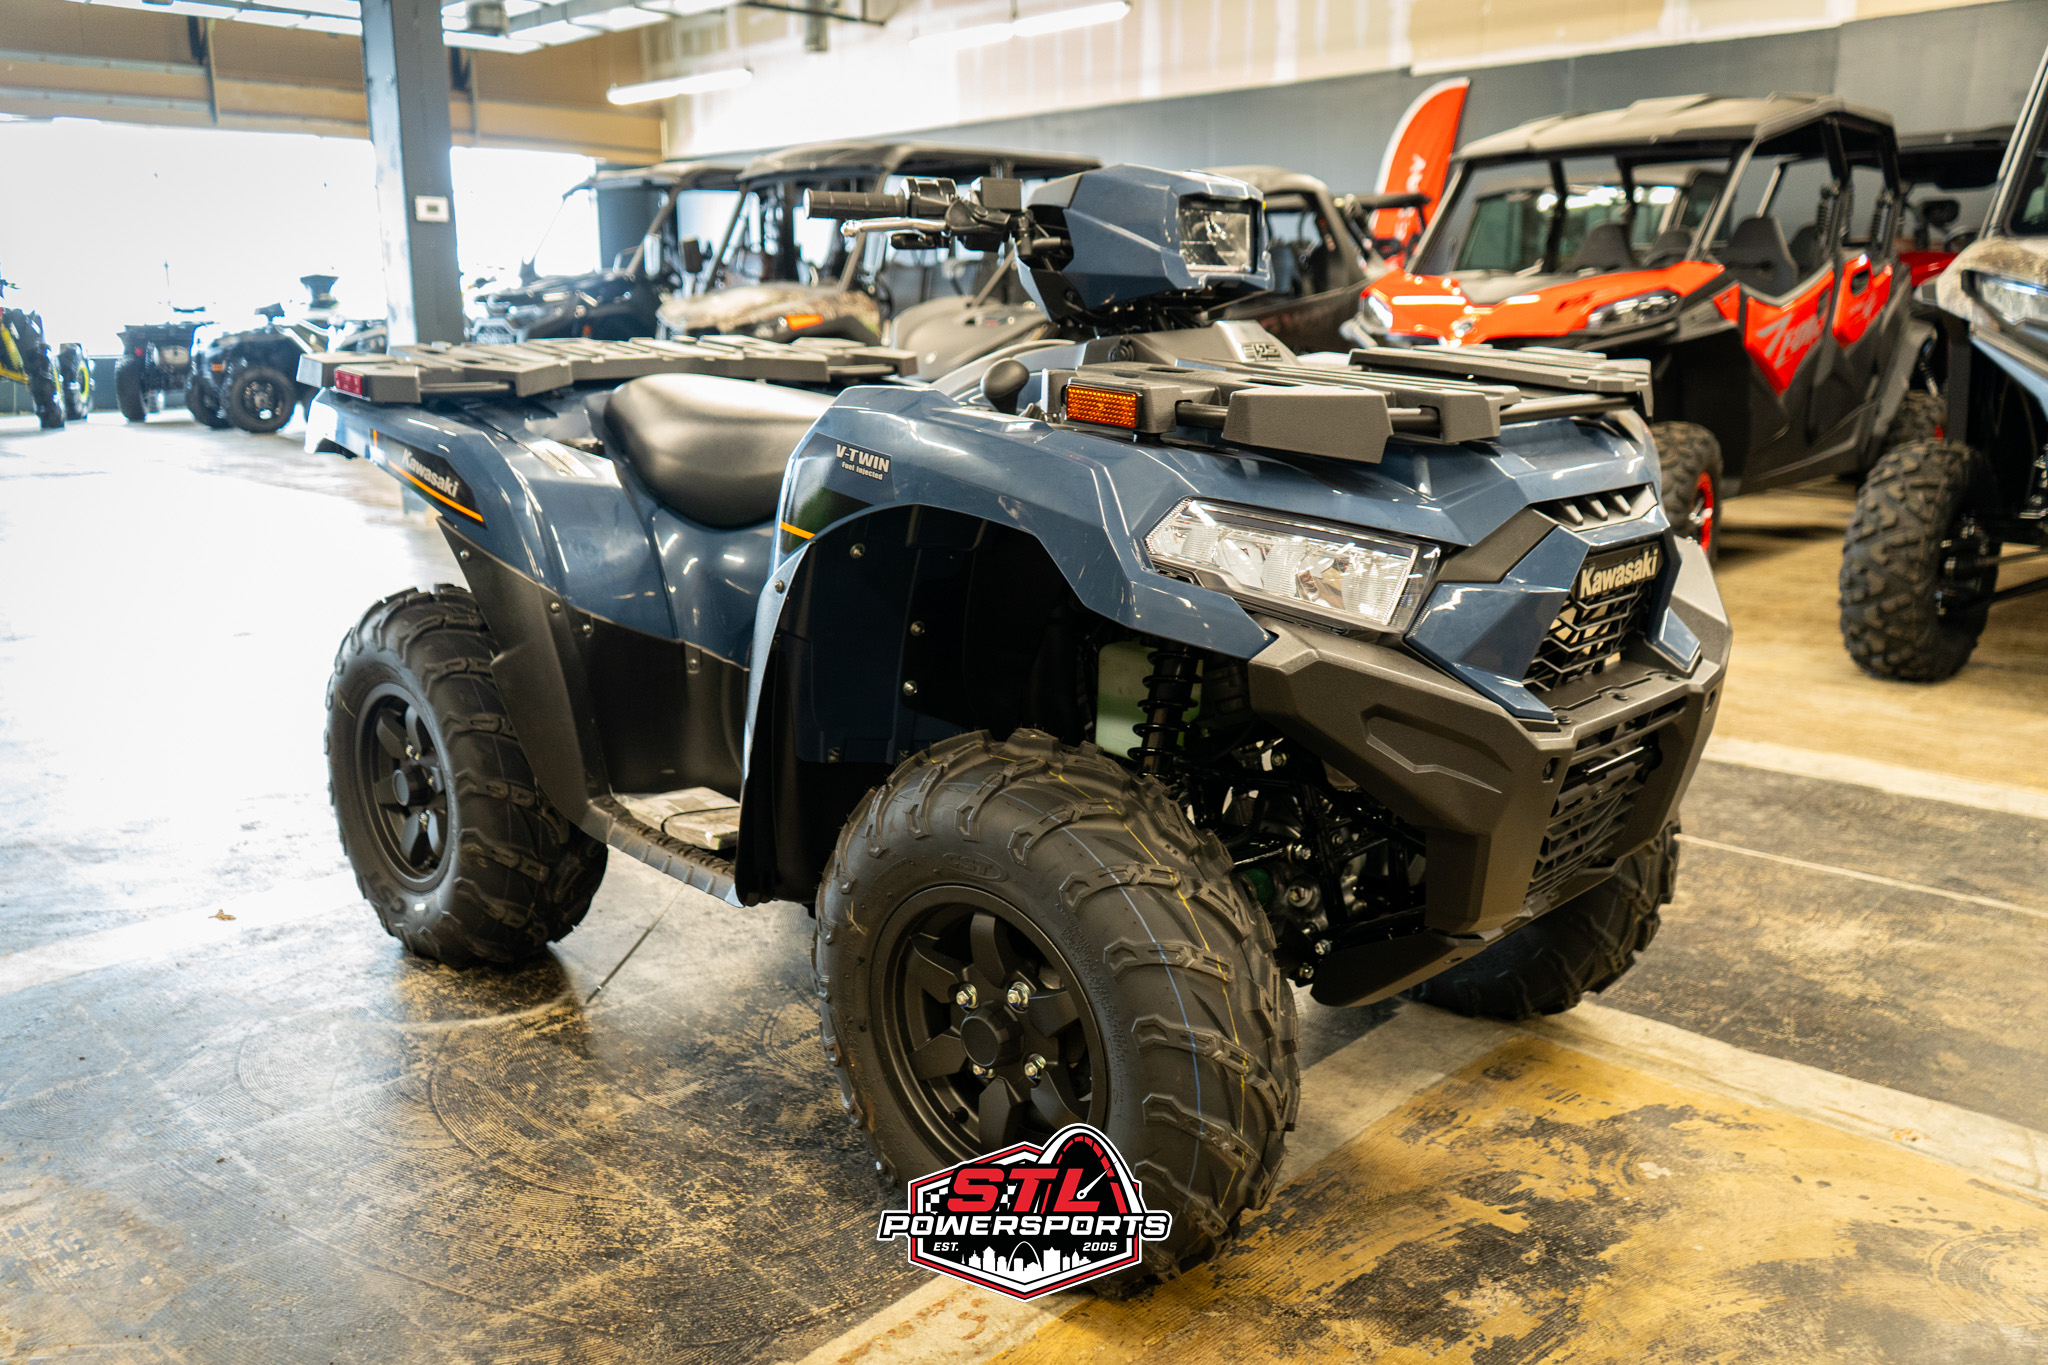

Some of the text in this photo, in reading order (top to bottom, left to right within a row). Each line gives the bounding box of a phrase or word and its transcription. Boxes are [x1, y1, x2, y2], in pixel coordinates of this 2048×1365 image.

[402, 447, 459, 498] Kawasaki
[836, 443, 890, 473] V-TWIN
[841, 461, 883, 481] Fuel Injected
[1580, 548, 1659, 599] Kawasaki
